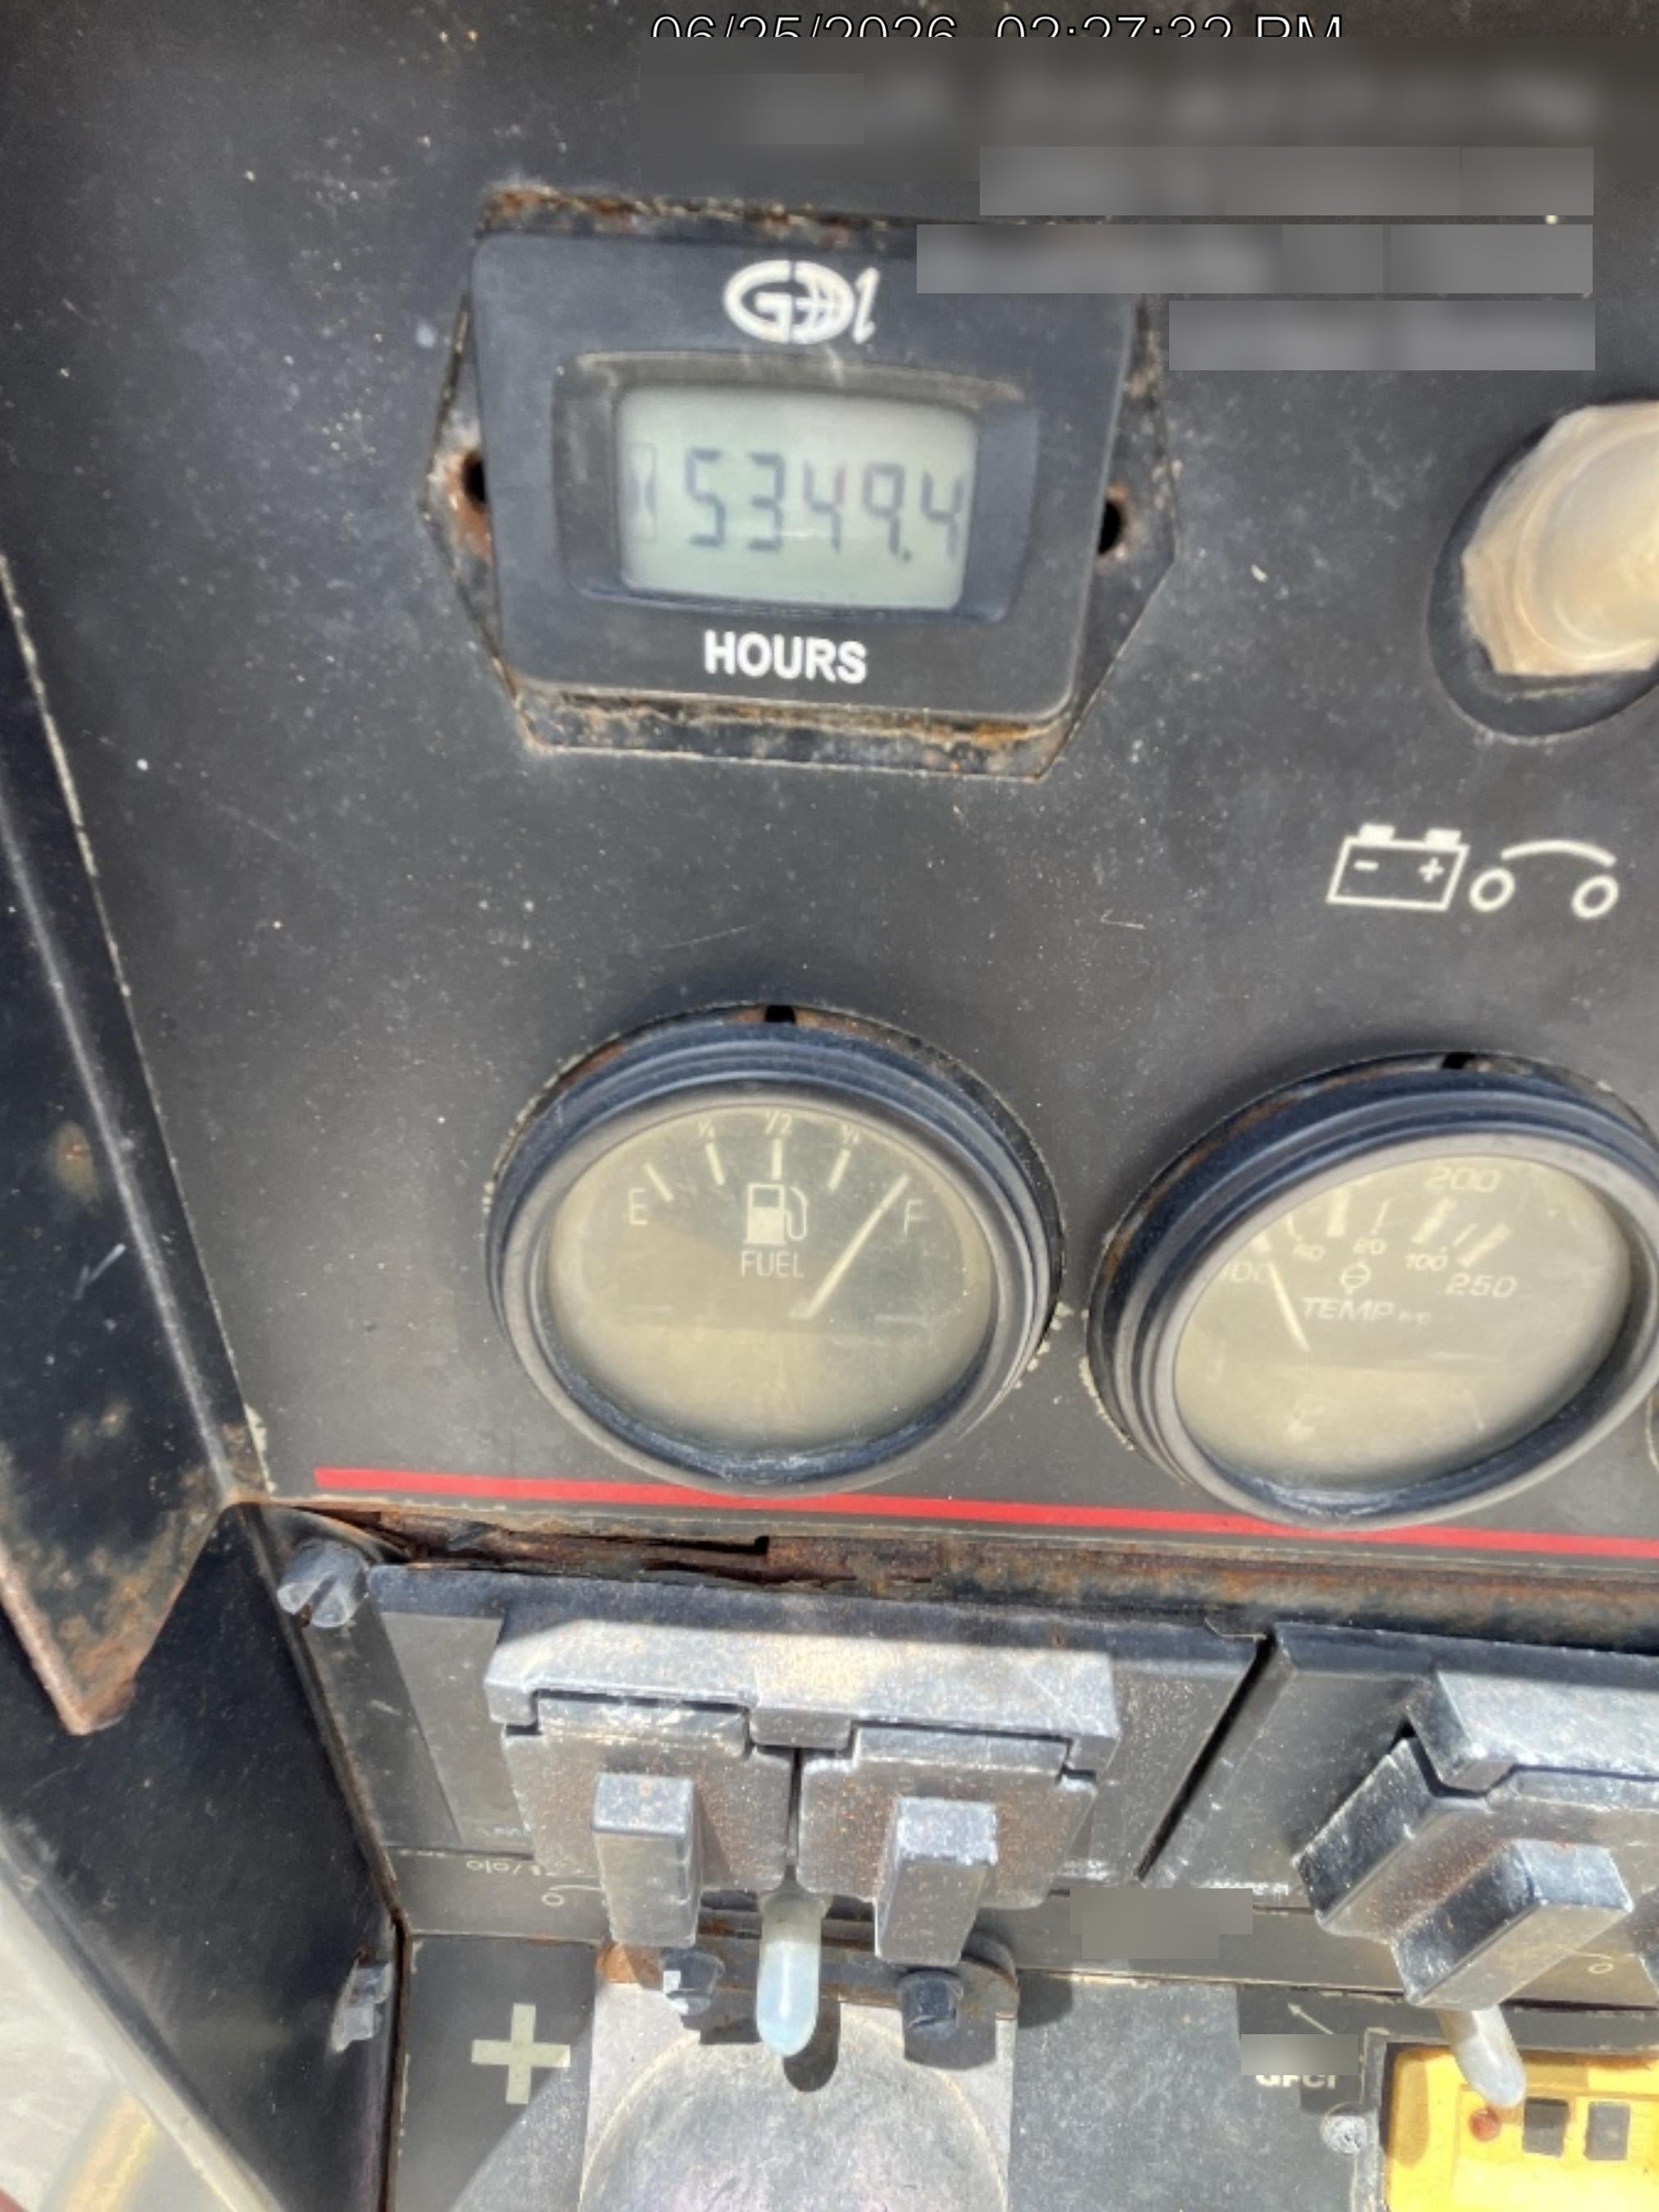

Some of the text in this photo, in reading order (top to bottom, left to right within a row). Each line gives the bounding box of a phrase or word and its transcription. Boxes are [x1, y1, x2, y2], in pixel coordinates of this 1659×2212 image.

[684, 447, 964, 565] 5349.4
[704, 628, 868, 686] HOURS
[1424, 1165, 1503, 1194] 200
[627, 1188, 649, 1225] E
[903, 1199, 924, 1237] F
[741, 1250, 805, 1278] FUEL
[1444, 1271, 1518, 1299] 250
[1301, 1297, 1395, 1322] TEMP
